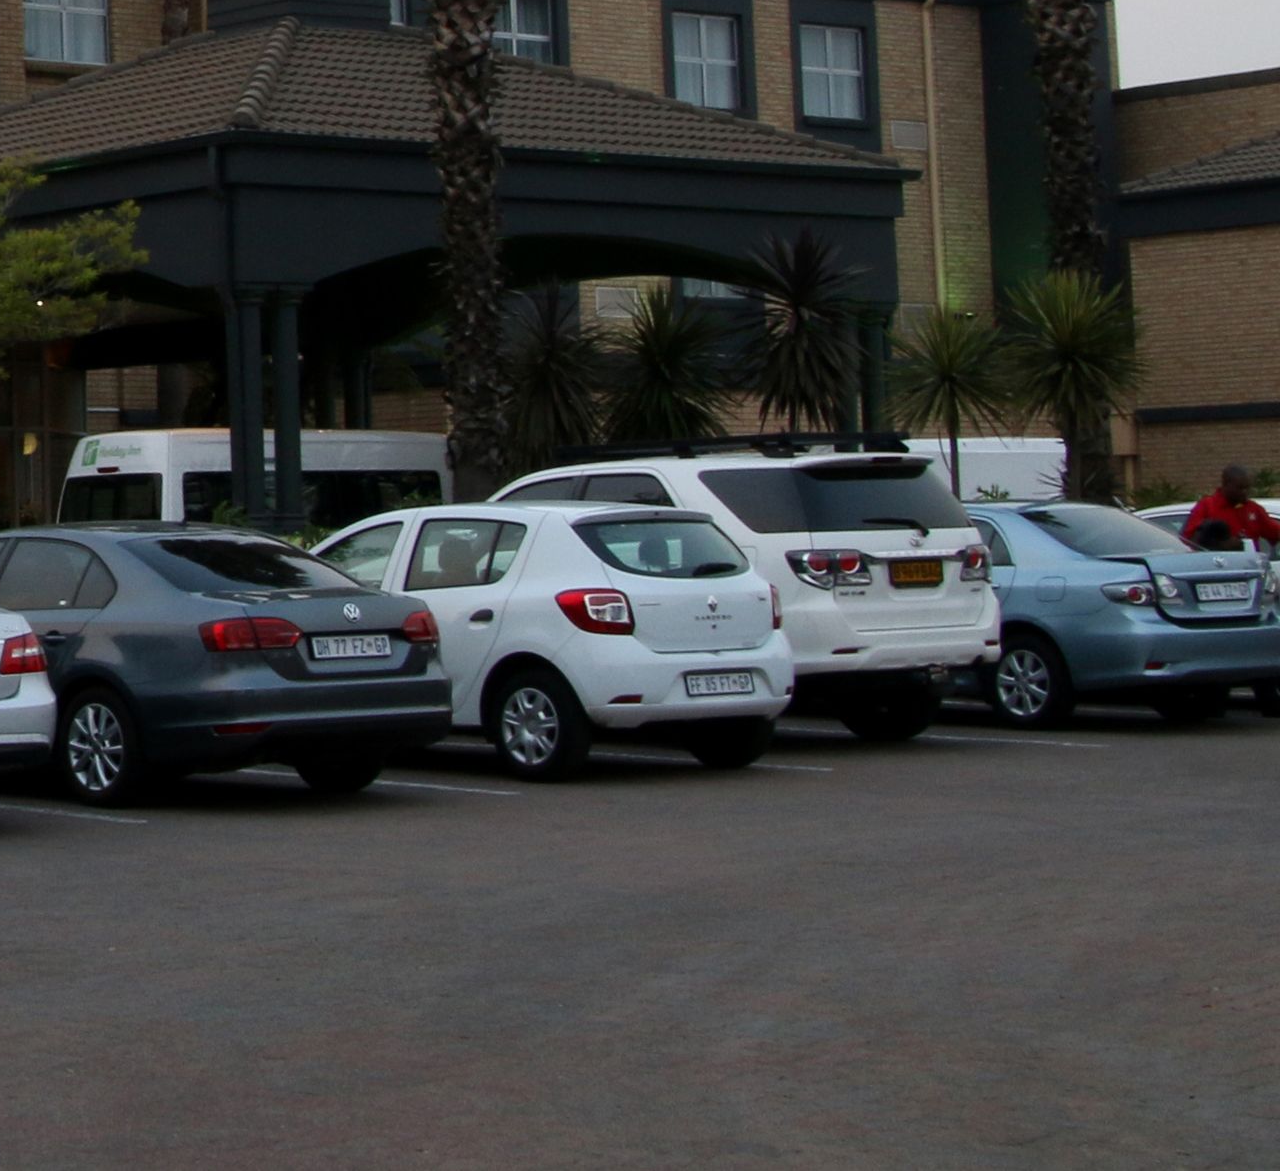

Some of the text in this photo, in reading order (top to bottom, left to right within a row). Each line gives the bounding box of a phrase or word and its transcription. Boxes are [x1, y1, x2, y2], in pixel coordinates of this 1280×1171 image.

[99, 445, 126, 459] Holiday
[333, 638, 347, 655] 77
[352, 637, 367, 654] FZ
[374, 637, 388, 654] GP
[719, 675, 732, 691] FT
[738, 675, 750, 690] GP
